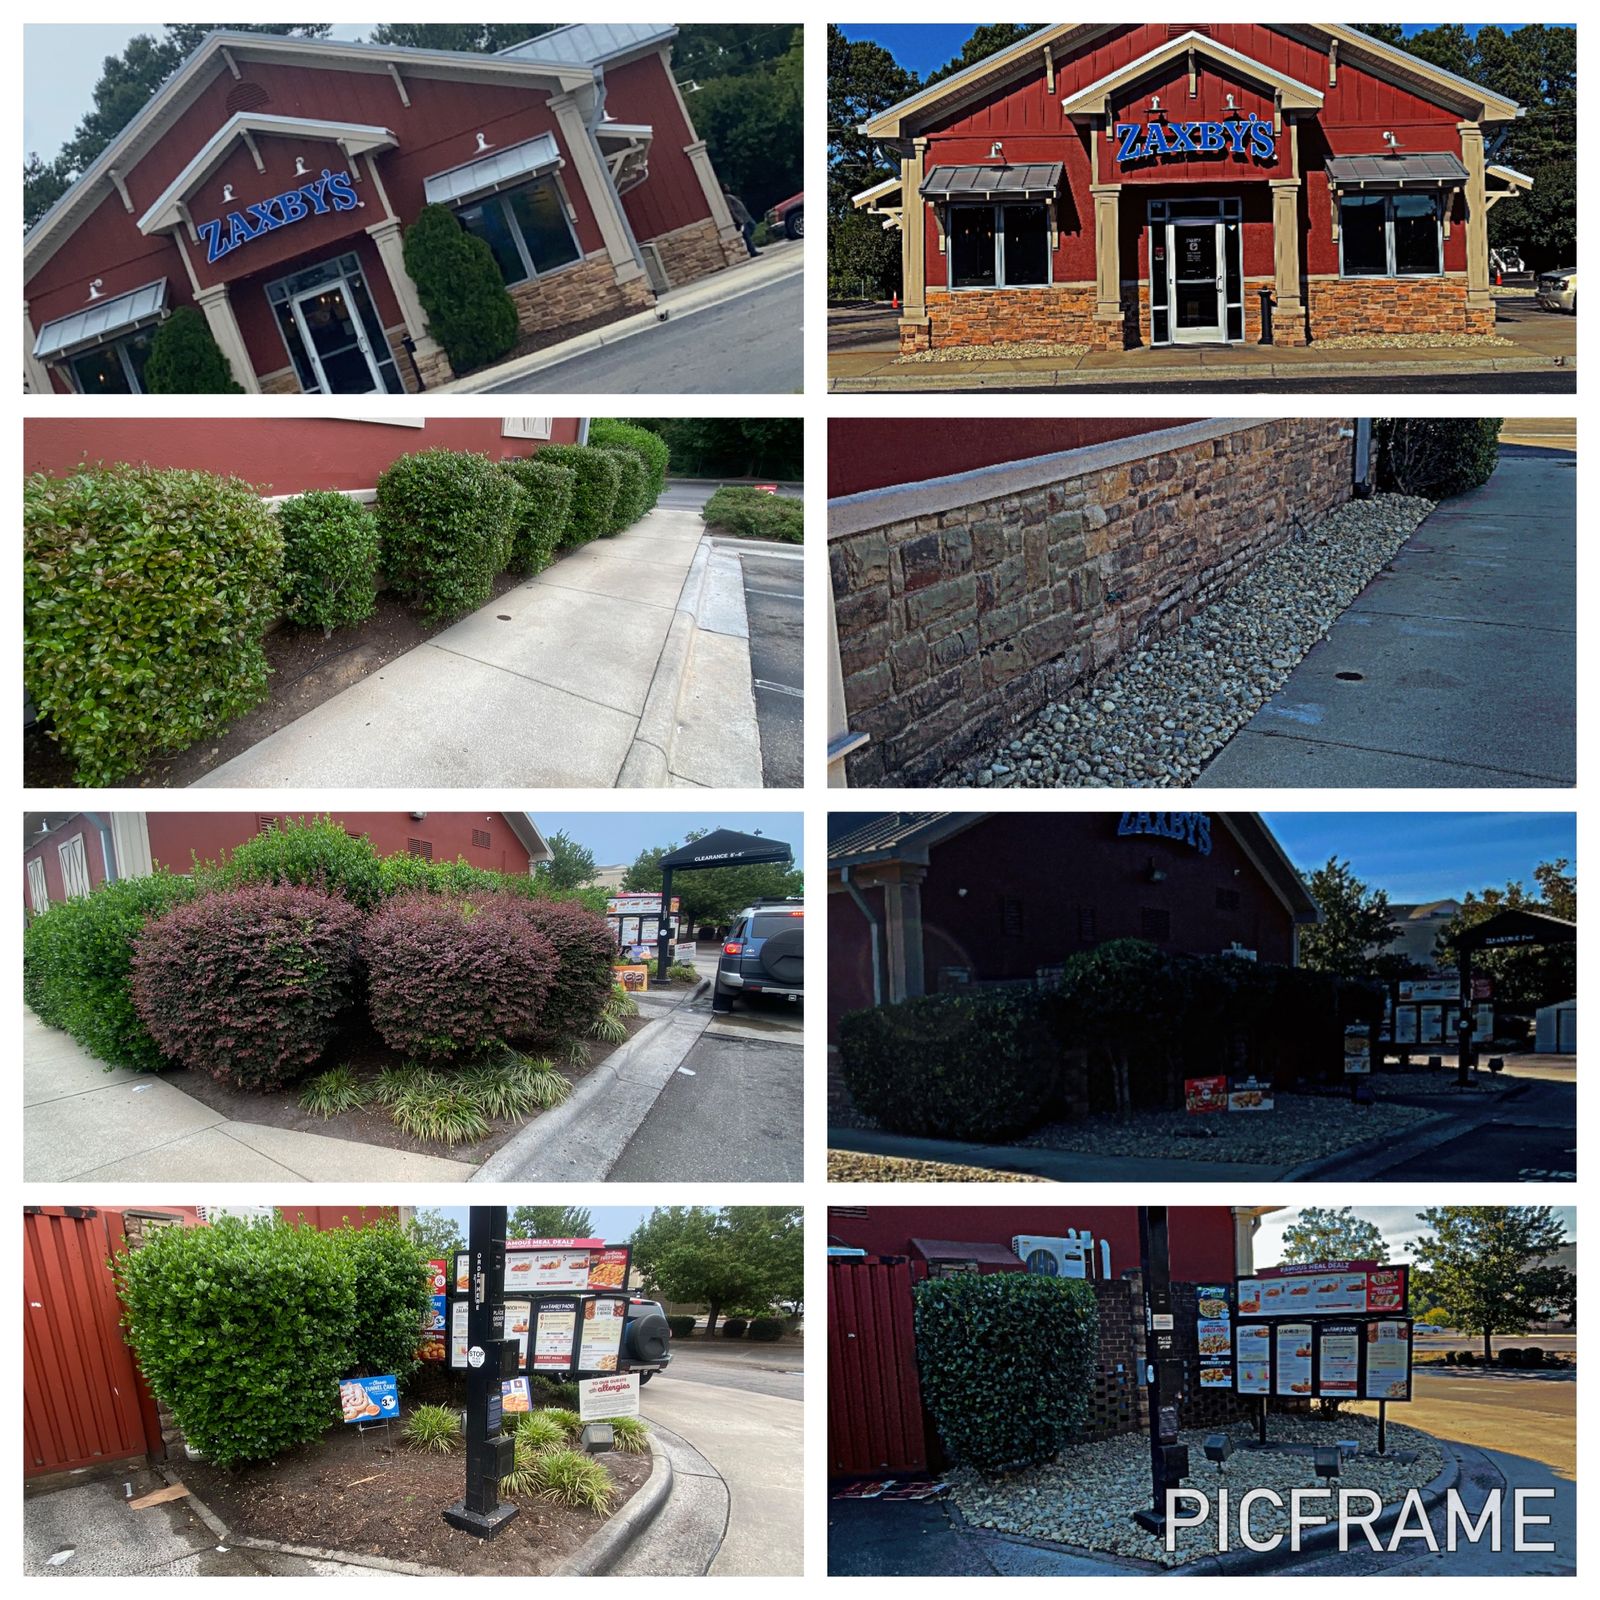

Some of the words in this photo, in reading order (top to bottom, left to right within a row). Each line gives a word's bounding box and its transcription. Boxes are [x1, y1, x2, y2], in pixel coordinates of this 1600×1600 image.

[1116, 112, 1275, 162] ZAXBY'S
[197, 168, 358, 264] ZAXBY'S
[694, 853, 729, 862] CLEARANCE
[1280, 1265, 1307, 1273] FAMOUS
[598, 1382, 631, 1393] allergies
